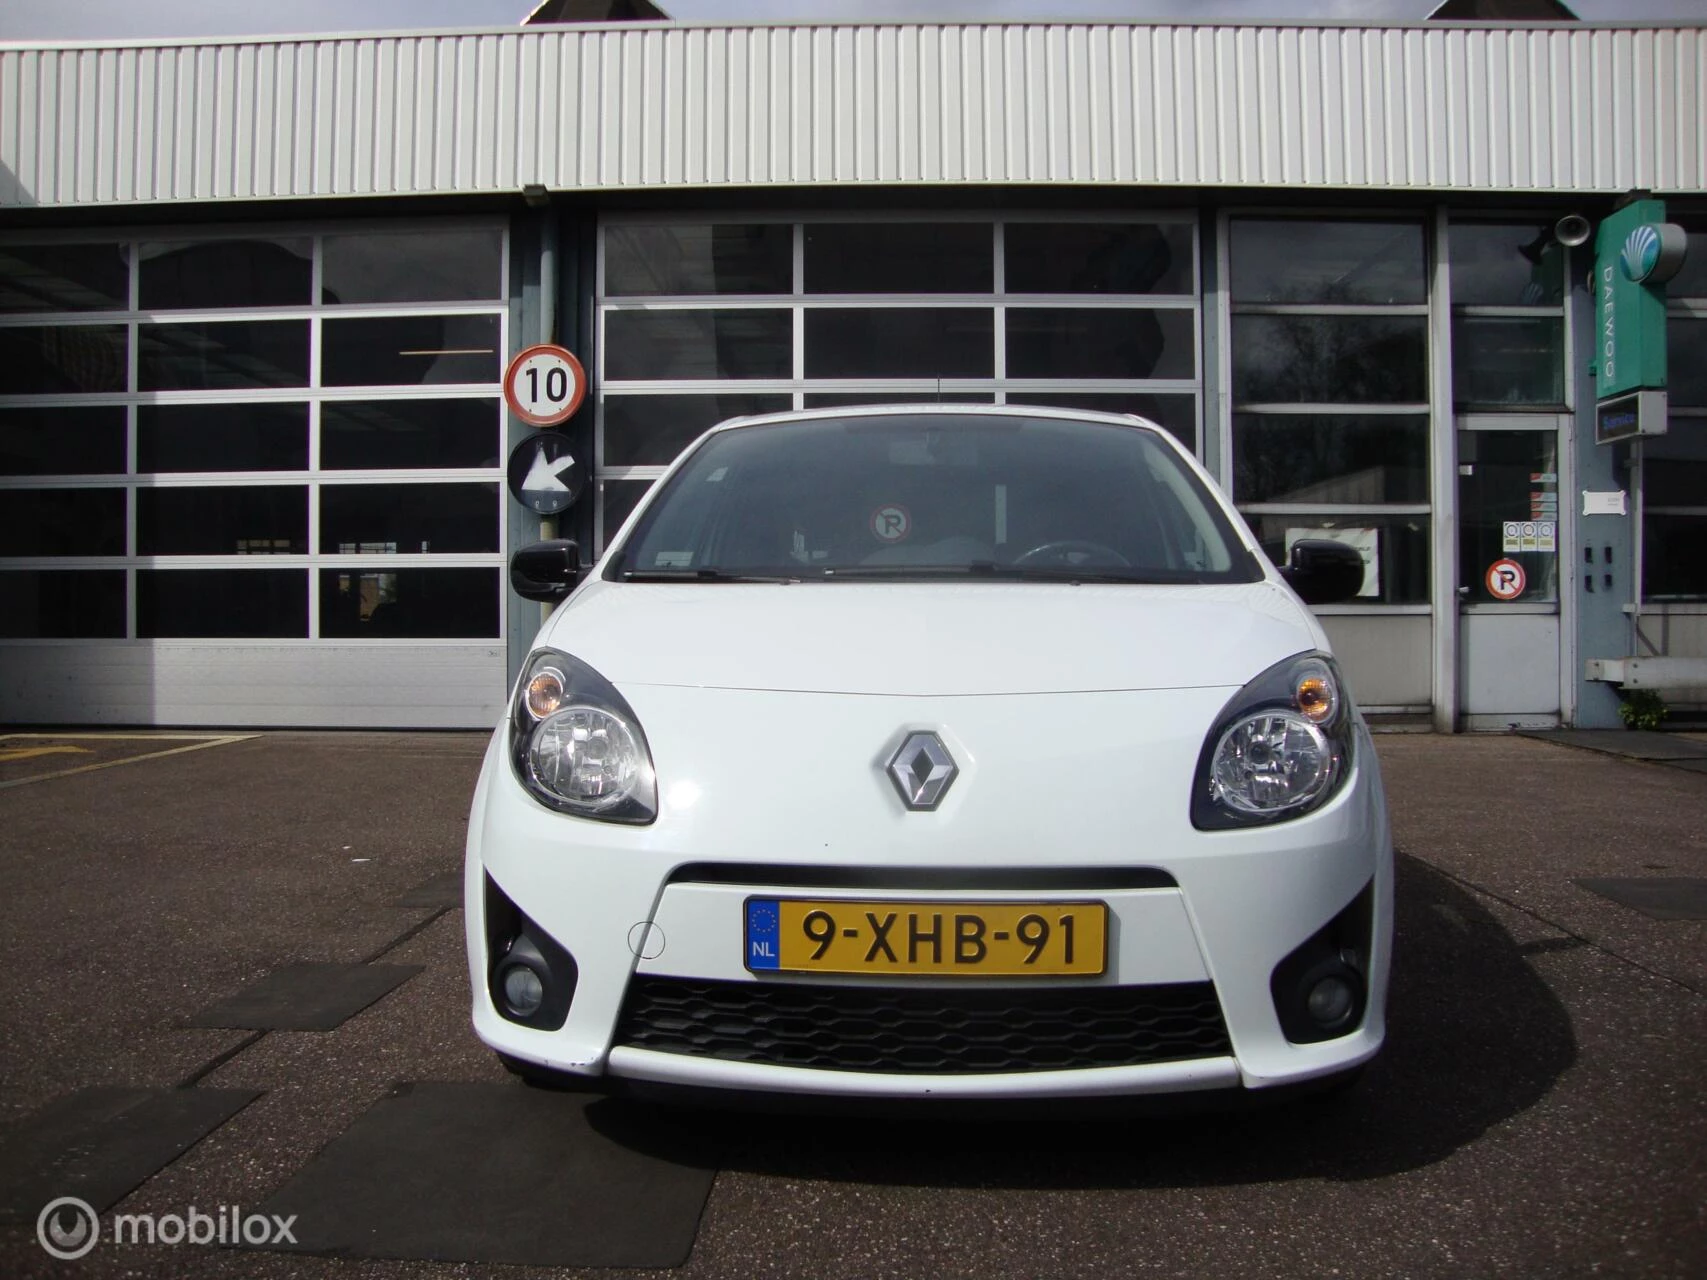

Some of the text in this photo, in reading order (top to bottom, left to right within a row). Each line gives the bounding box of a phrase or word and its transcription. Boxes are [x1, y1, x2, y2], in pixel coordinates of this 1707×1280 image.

[1603, 265, 1615, 377] DAEWOO
[526, 367, 567, 403] 10
[753, 941, 775, 957] NL
[802, 909, 1075, 964] 9-XHB-91
